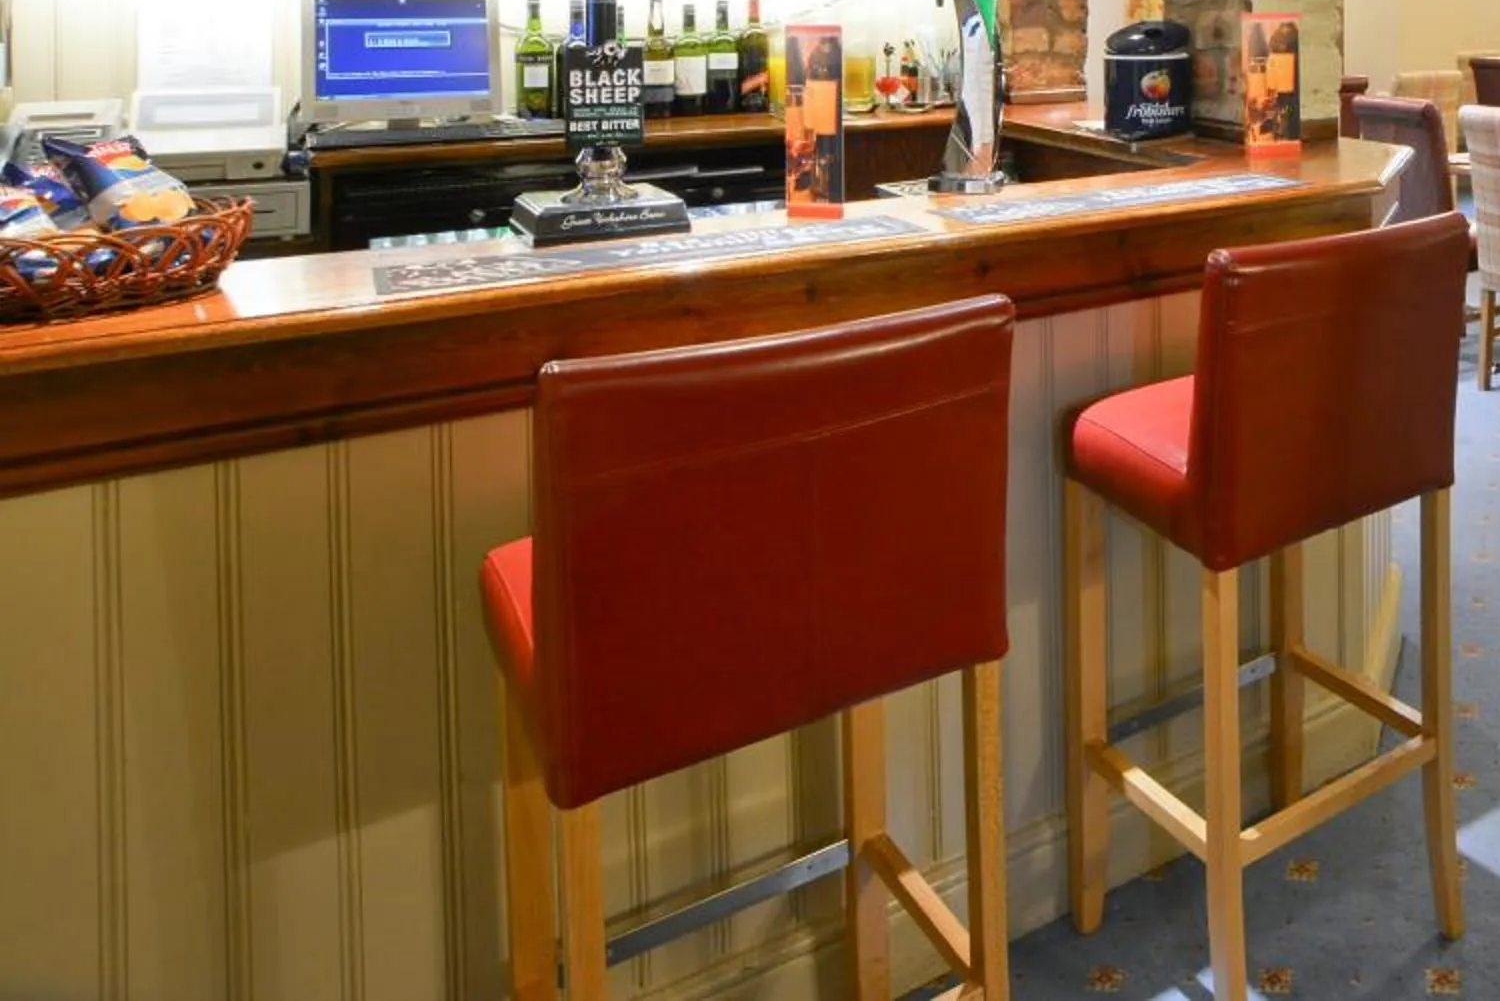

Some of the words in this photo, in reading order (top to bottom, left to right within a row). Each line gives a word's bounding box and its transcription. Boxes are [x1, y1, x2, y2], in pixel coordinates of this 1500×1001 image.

[568, 67, 642, 88] BLACK
[568, 86, 642, 106] SHEEP
[568, 120, 599, 133] BEST
[601, 118, 641, 132] BITTER
